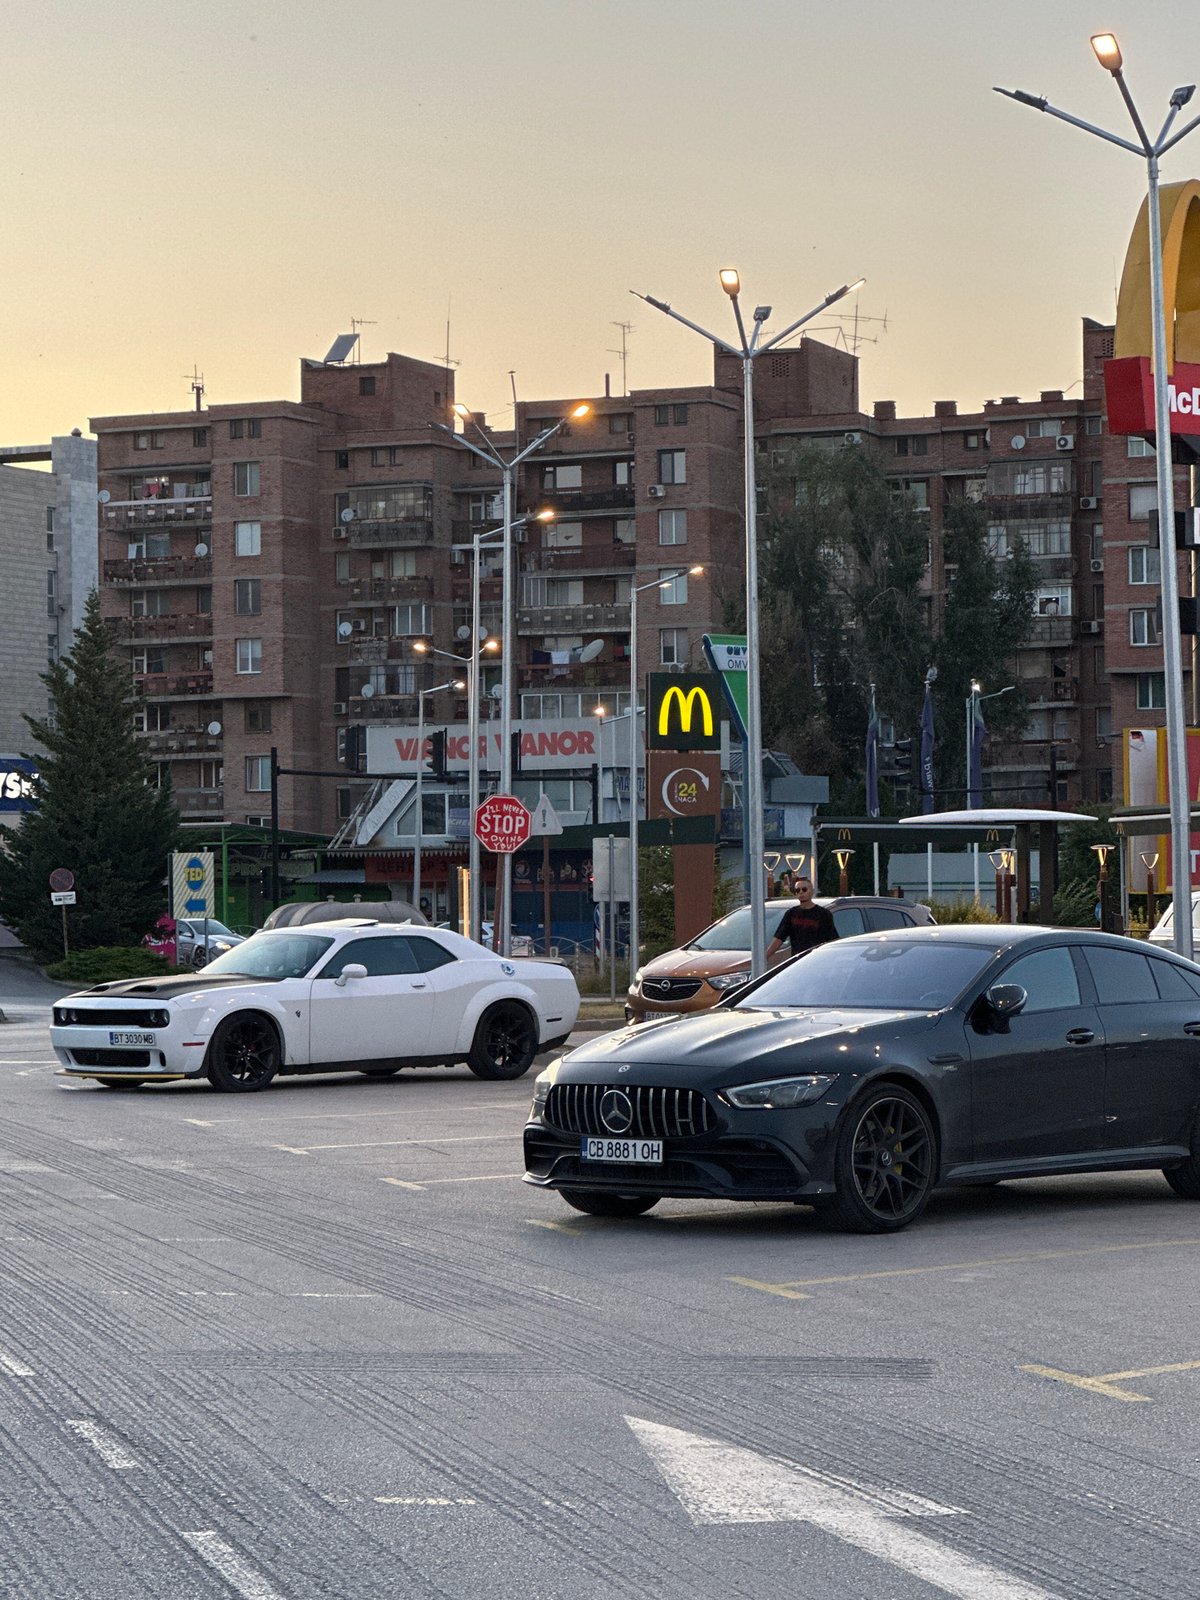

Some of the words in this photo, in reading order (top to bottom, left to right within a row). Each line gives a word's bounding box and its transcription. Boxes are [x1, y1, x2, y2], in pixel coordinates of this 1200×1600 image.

[678, 782, 697, 797] 24
[502, 803, 525, 815] NEVER
[480, 813, 526, 835] STOP
[480, 833, 524, 844] LOVING
[125, 1034, 143, 1044] 3030
[588, 1140, 604, 1158] CB
[606, 1141, 638, 1159] 8881
[641, 1142, 661, 1160] OH
